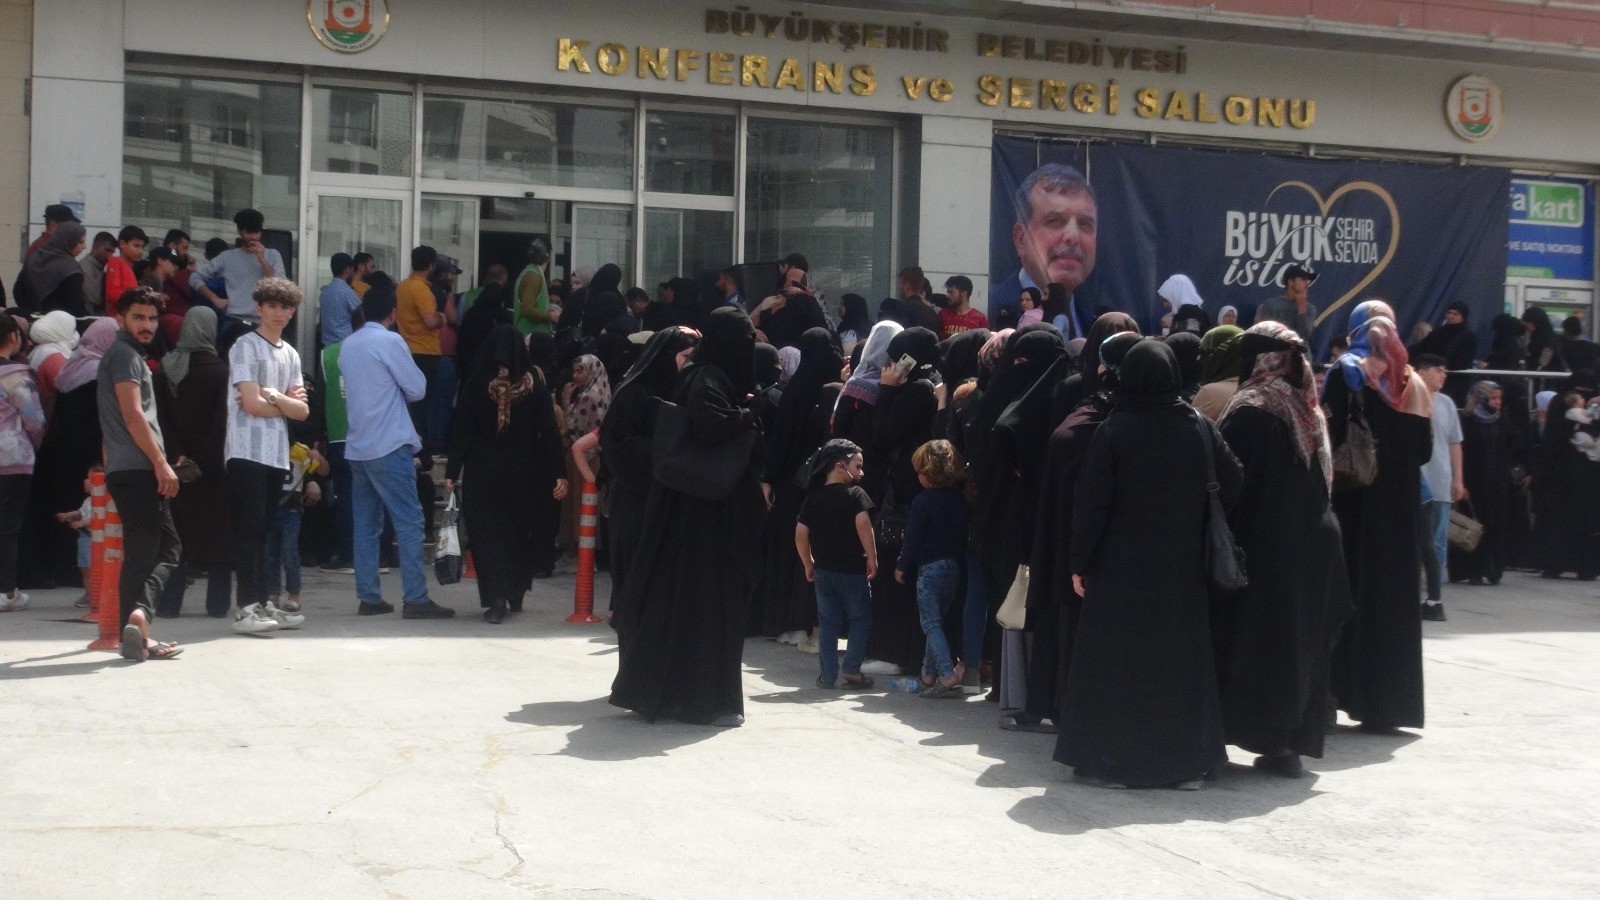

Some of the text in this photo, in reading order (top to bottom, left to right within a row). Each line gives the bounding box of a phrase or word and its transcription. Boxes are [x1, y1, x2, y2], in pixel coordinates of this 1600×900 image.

[705, 5, 1187, 75] BÜYÜKŞEHİR BELEDİYESİ
[557, 38, 1317, 130] KONFERANS ve SERGİ SALONU
[1335, 240, 1379, 265] SEVDA
